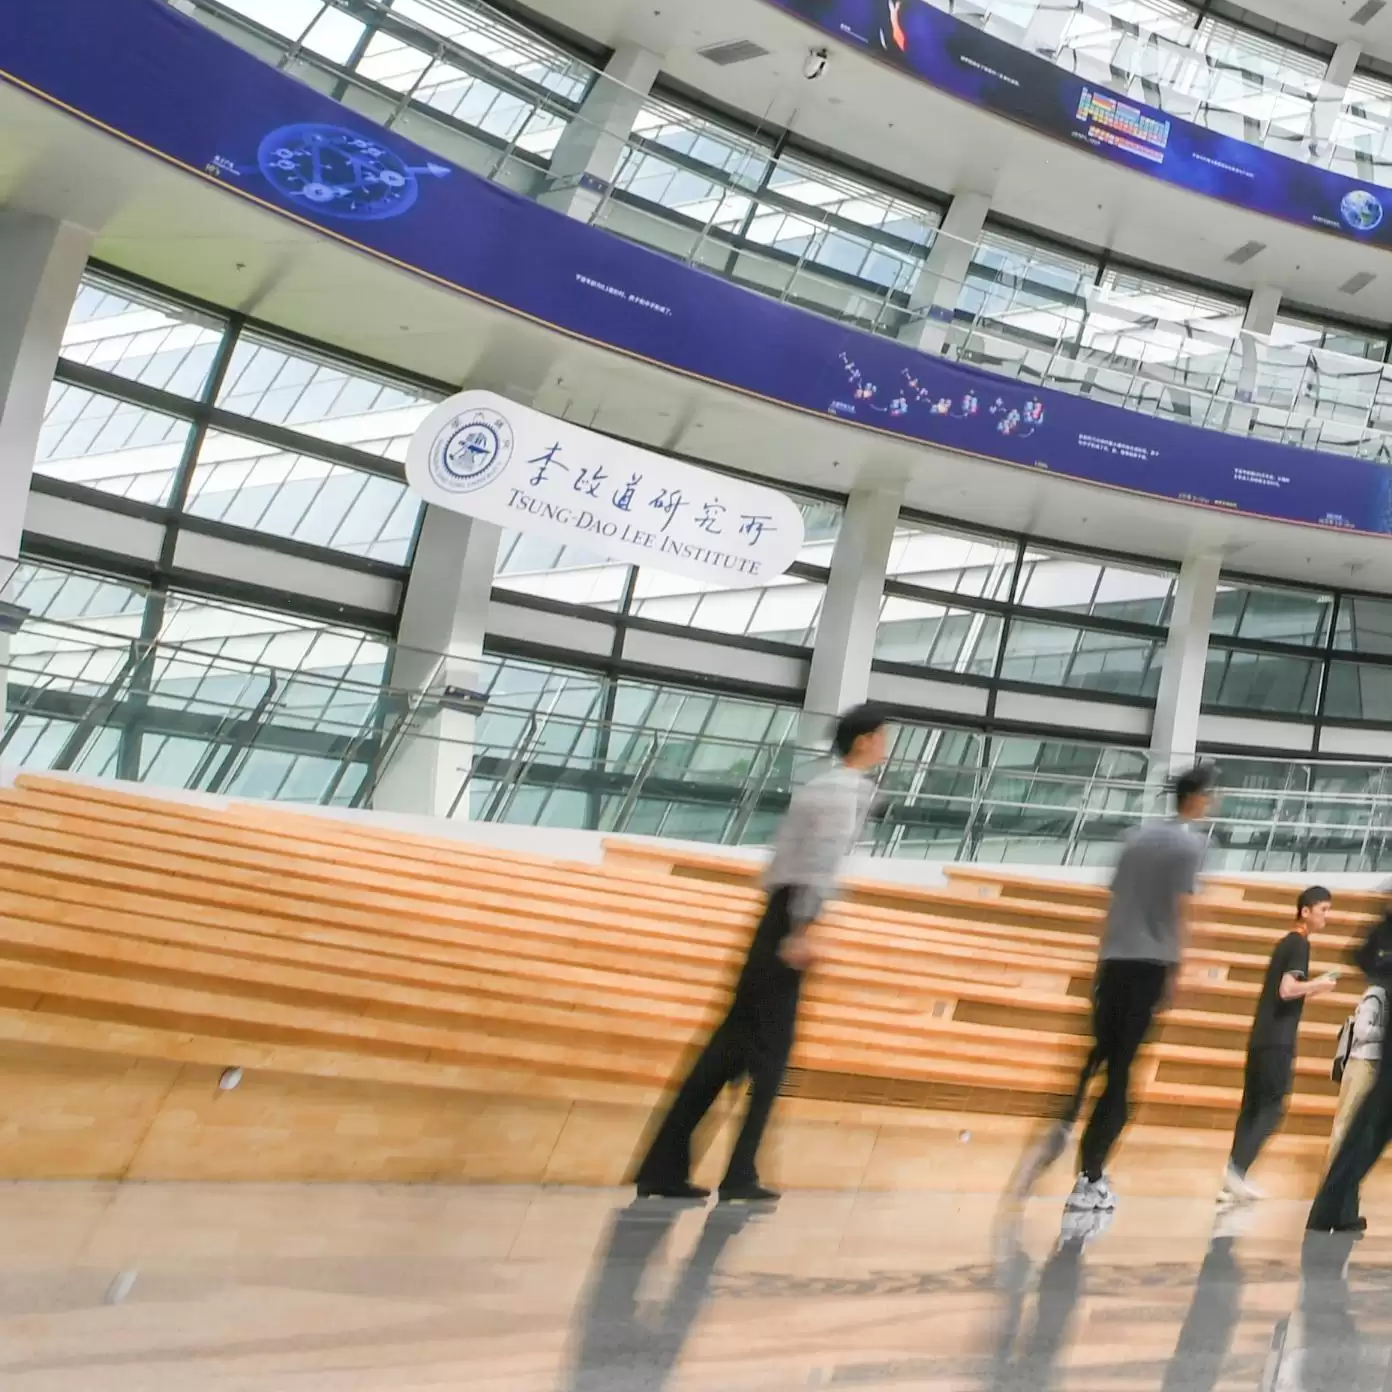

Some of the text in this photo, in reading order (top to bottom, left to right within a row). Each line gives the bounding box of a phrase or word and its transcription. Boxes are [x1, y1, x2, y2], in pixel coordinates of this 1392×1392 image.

[507, 488, 763, 576] TSUNG-DAO LEE INSTITUTE
[528, 442, 778, 546] 李政道研究所
